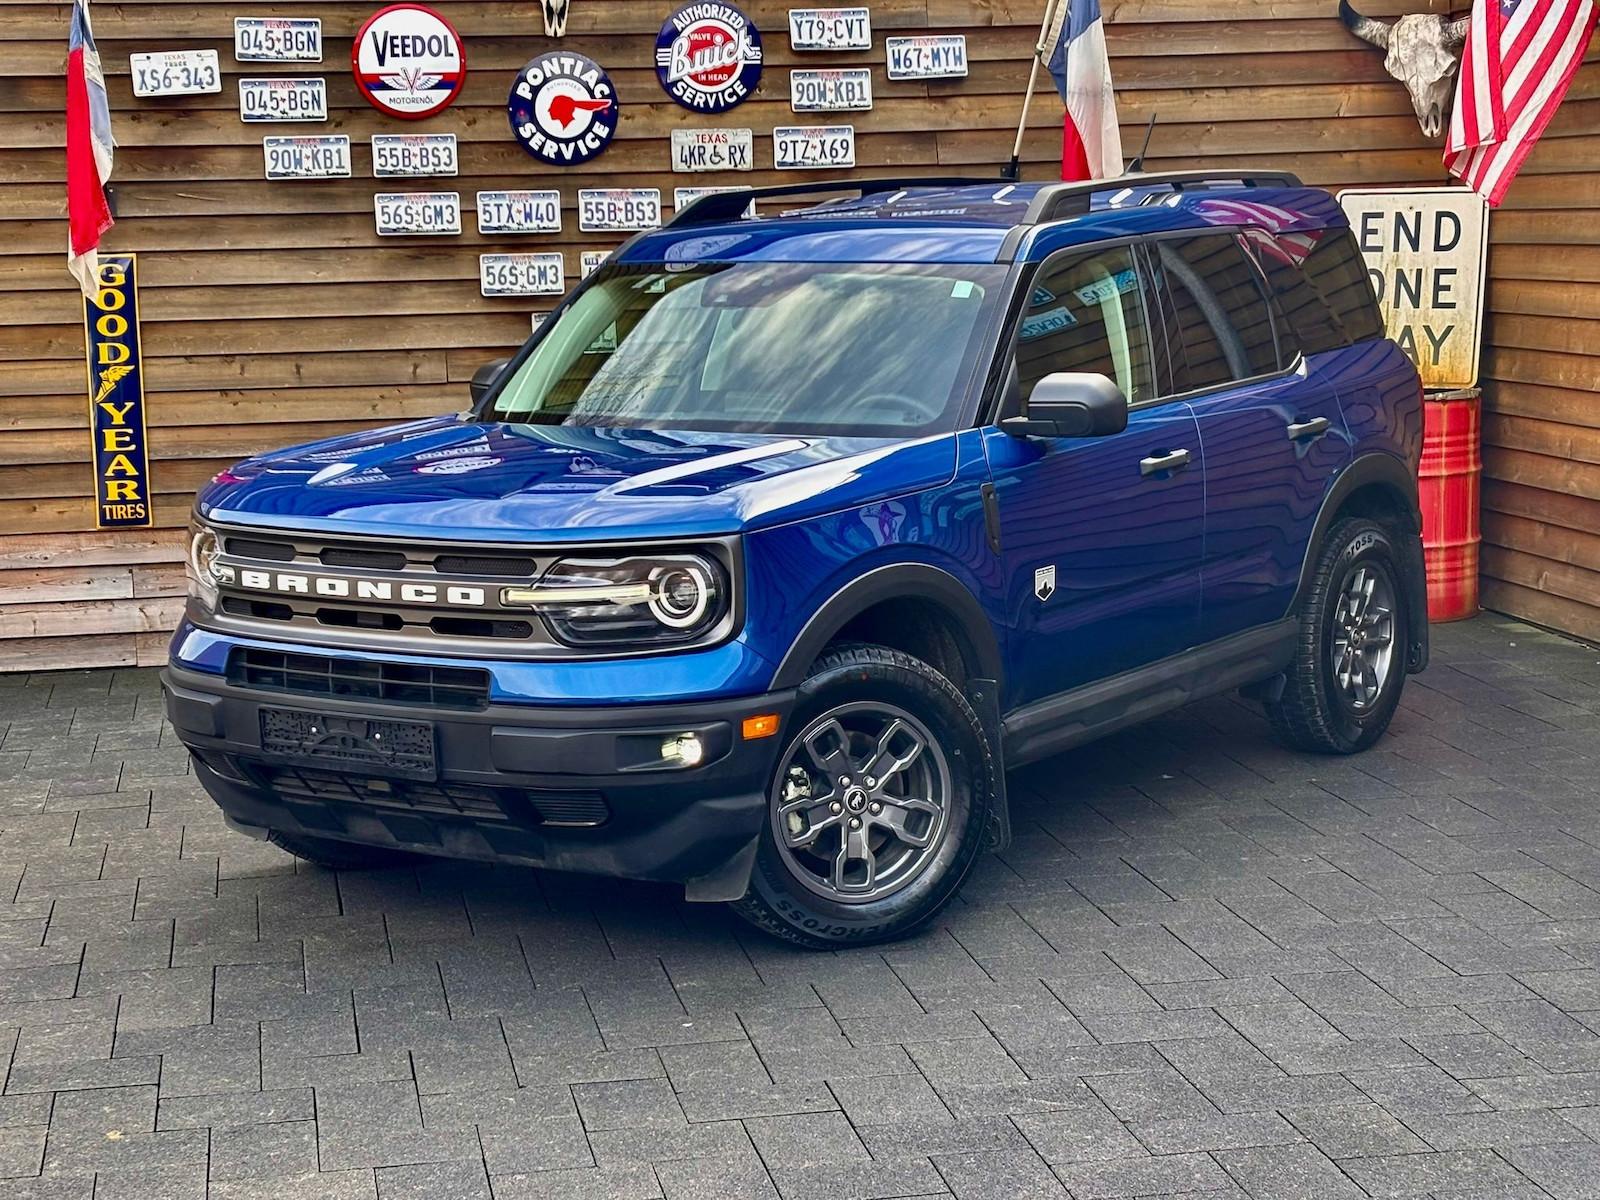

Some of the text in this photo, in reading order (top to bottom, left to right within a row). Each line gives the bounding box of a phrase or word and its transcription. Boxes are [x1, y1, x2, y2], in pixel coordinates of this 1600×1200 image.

[672, 4, 744, 32] AUTHORIZED
[371, 30, 454, 67] VEEDOL
[689, 33, 711, 41] VALVE
[667, 26, 761, 83] Buick
[516, 57, 610, 100] PONTIAC
[698, 73, 706, 81] IN
[672, 80, 747, 108] SERVICE
[519, 121, 610, 160] SERVICE
[696, 133, 728, 144] TEXAS
[680, 144, 746, 166] 4KR RX
[1360, 211, 1462, 252] END
[1385, 325, 1455, 366] AY
[102, 503, 146, 520] TIRES
[241, 569, 485, 606] BRONCO
